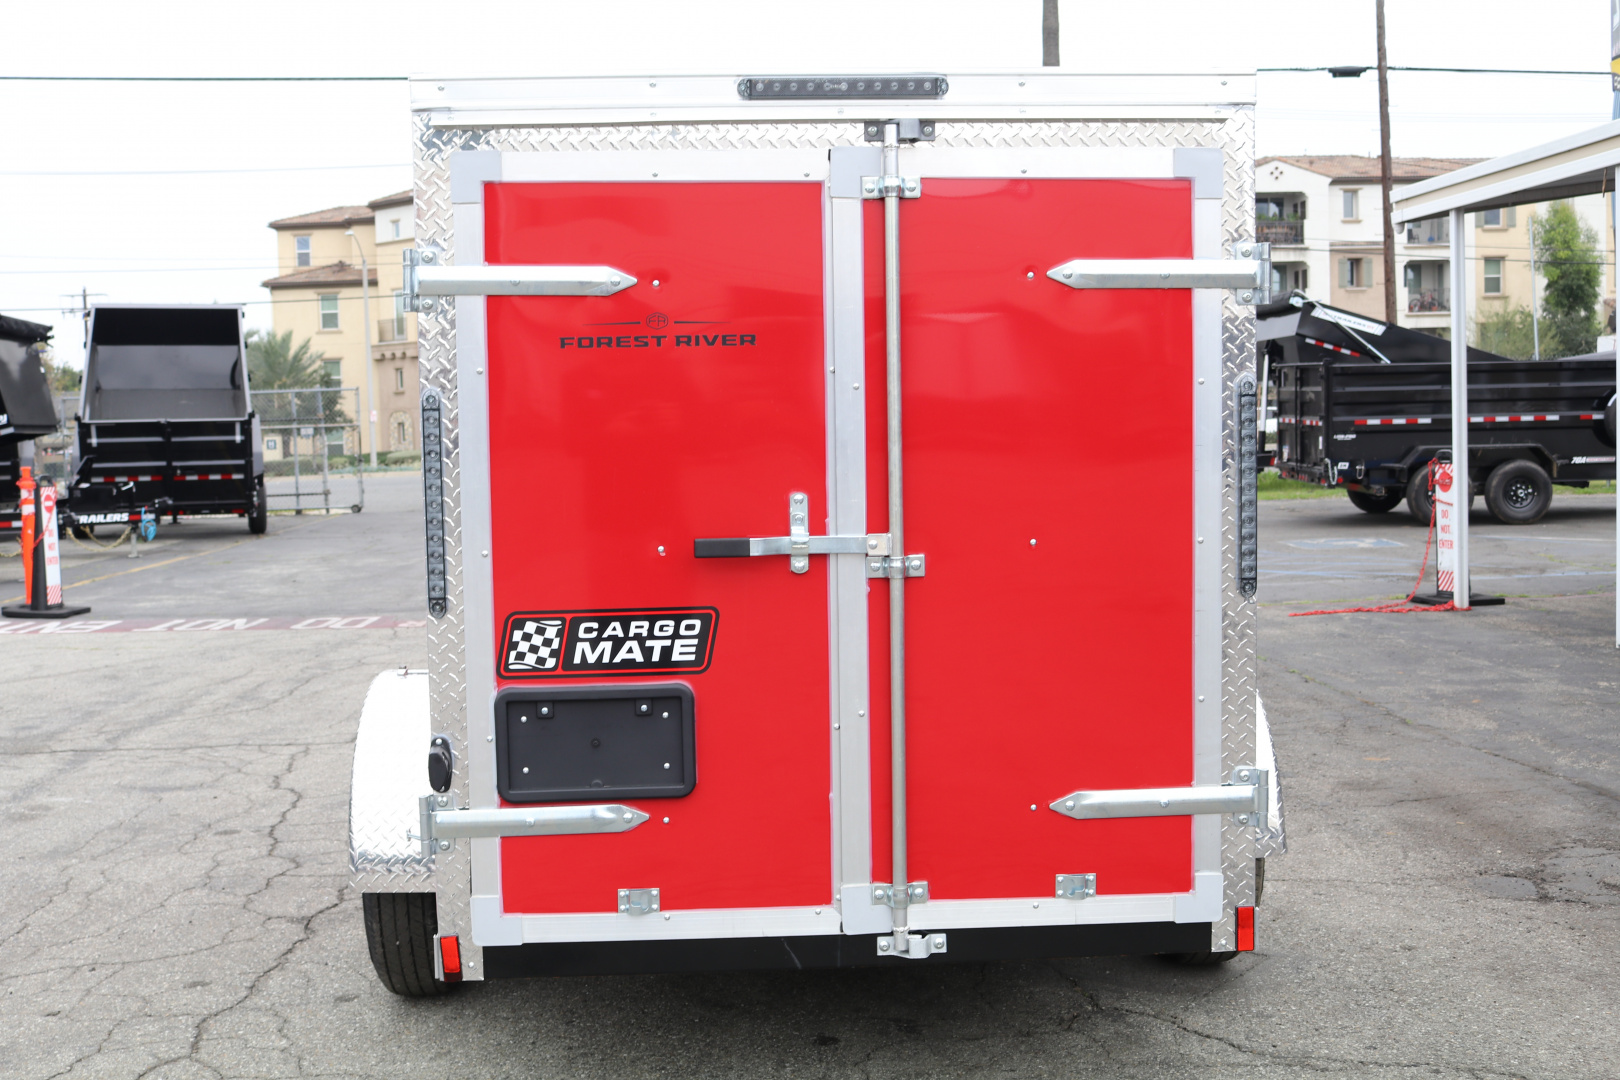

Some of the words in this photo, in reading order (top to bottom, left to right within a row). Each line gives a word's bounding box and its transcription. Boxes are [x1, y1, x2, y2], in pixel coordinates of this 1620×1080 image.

[559, 335, 668, 349] FOREST
[674, 334, 757, 347] RIVER
[78, 512, 129, 524] RAILERS
[1441, 509, 1449, 519] DO
[1440, 524, 1451, 534] NOT
[1438, 539, 1454, 550] ENTER
[132, 617, 270, 631] NOT
[290, 616, 381, 629] DO
[577, 619, 702, 639] CARGO
[572, 638, 700, 665] MATE
